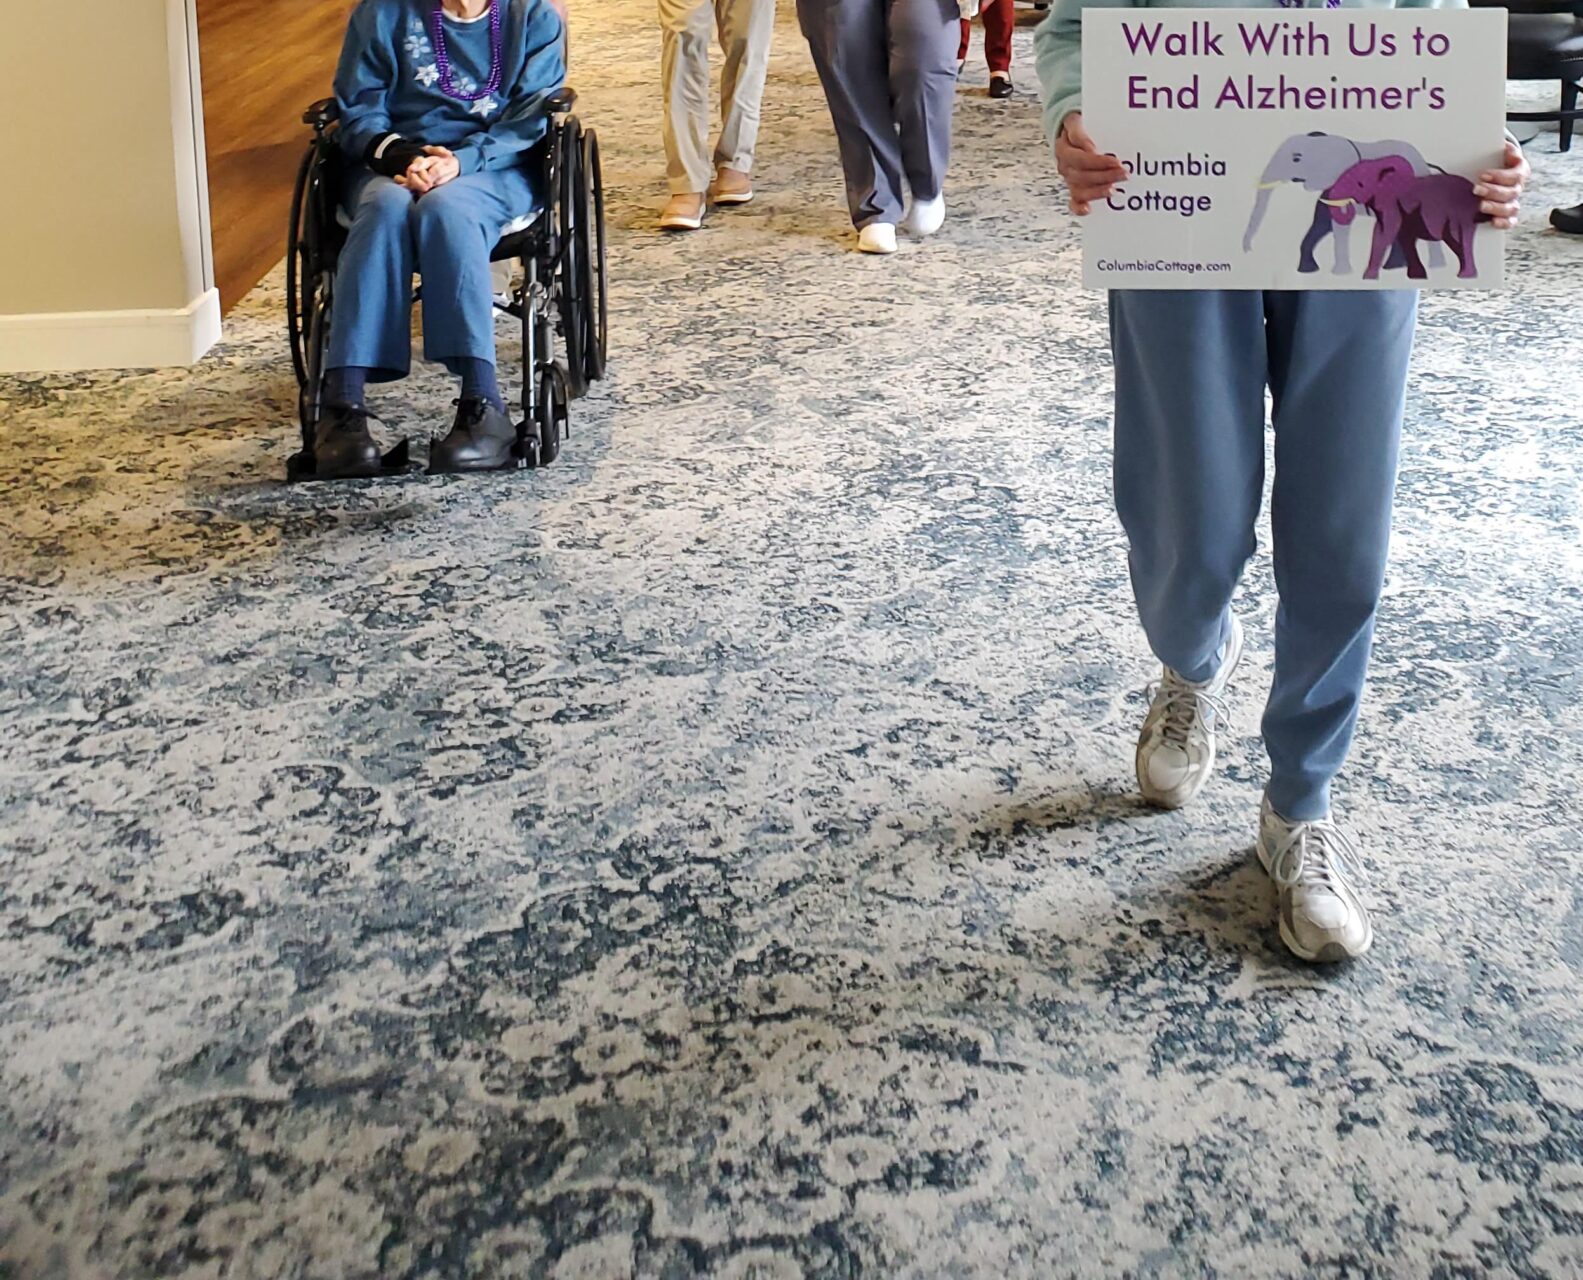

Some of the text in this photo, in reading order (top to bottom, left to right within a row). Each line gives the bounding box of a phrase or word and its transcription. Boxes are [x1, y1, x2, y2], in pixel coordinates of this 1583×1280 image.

[1121, 21, 1451, 57] Walk With Us to
[1128, 74, 1446, 110] End Alzheimer's
[1104, 151, 1227, 177] olumbia
[1106, 187, 1212, 217] Cottage
[1096, 259, 1232, 274] ColumbiaCottage.com
